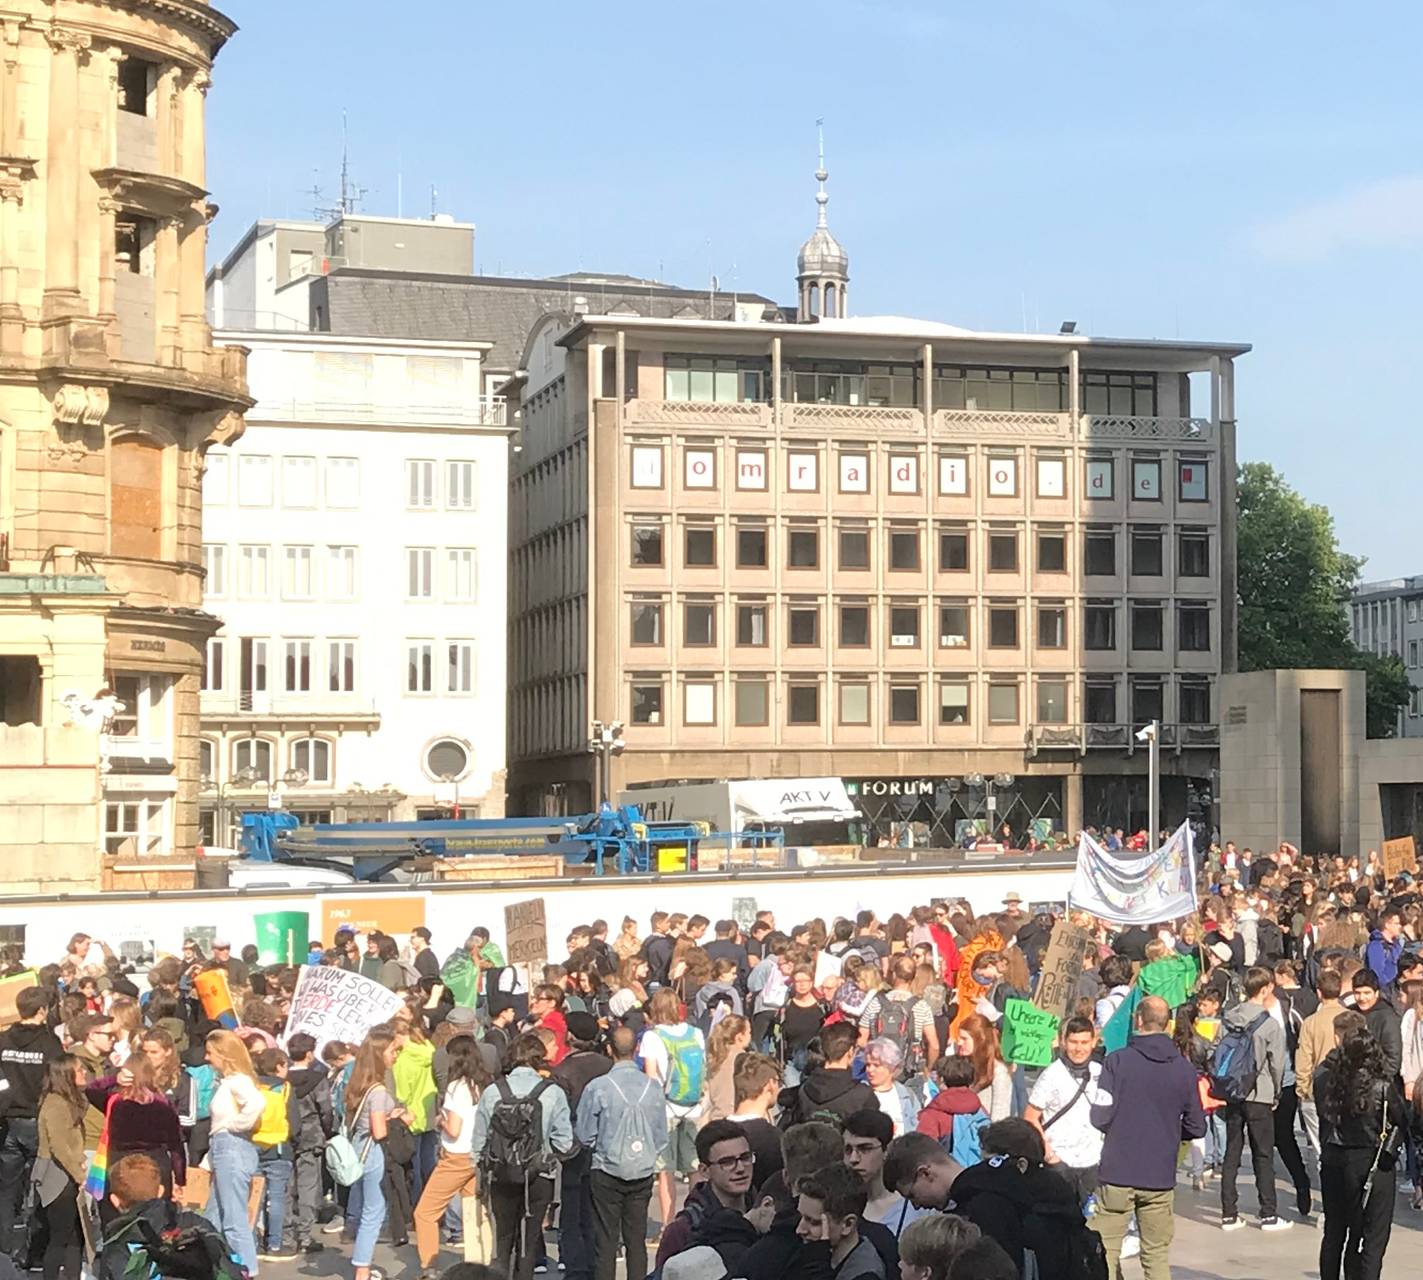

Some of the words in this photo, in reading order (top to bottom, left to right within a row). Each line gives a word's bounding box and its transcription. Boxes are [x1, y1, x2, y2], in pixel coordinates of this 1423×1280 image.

[862, 781, 933, 795] FORUM
[779, 791, 811, 804] AKT
[818, 791, 831, 801] V
